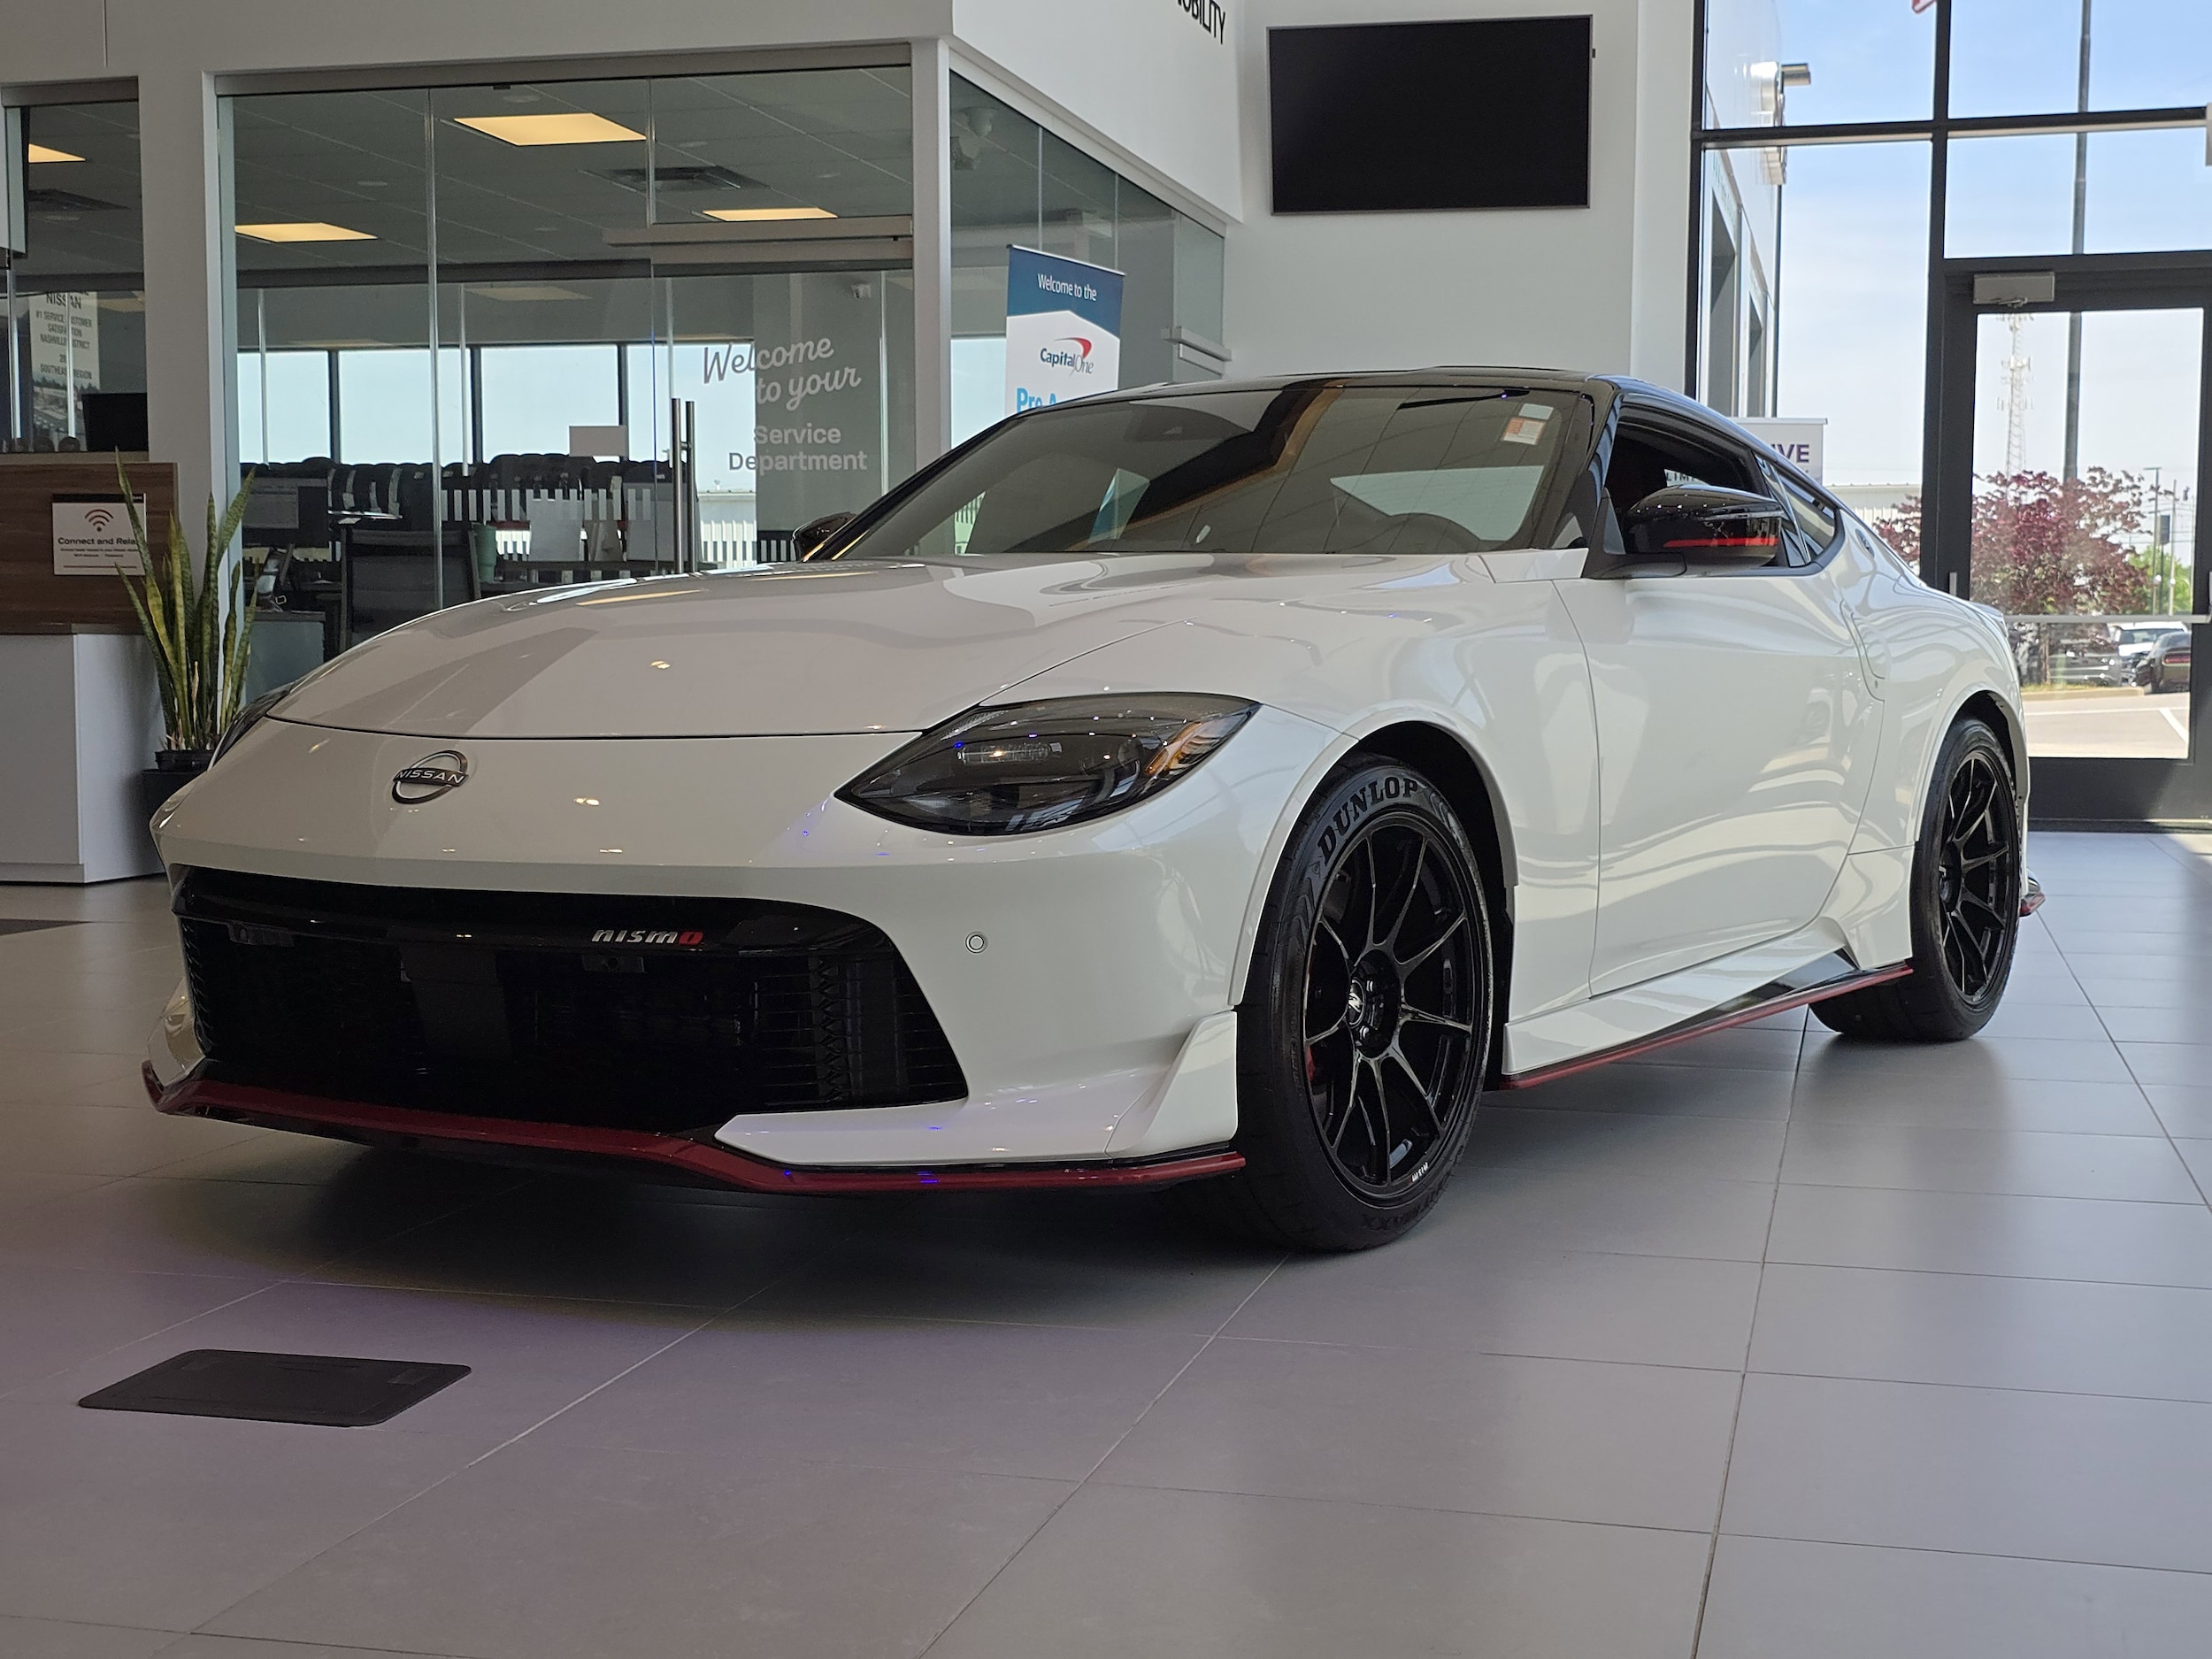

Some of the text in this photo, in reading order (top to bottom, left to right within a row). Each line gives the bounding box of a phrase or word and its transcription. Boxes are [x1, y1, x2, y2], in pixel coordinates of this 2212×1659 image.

[1038, 273, 1097, 302] Welcome to the
[703, 337, 834, 385] Welcome
[756, 366, 862, 411] to your
[753, 422, 841, 446] Service
[728, 450, 868, 476] Department
[58, 537, 137, 546] Connect and Rela
[396, 770, 465, 784] NISSAN
[1317, 776, 1419, 866] DUNLOP
